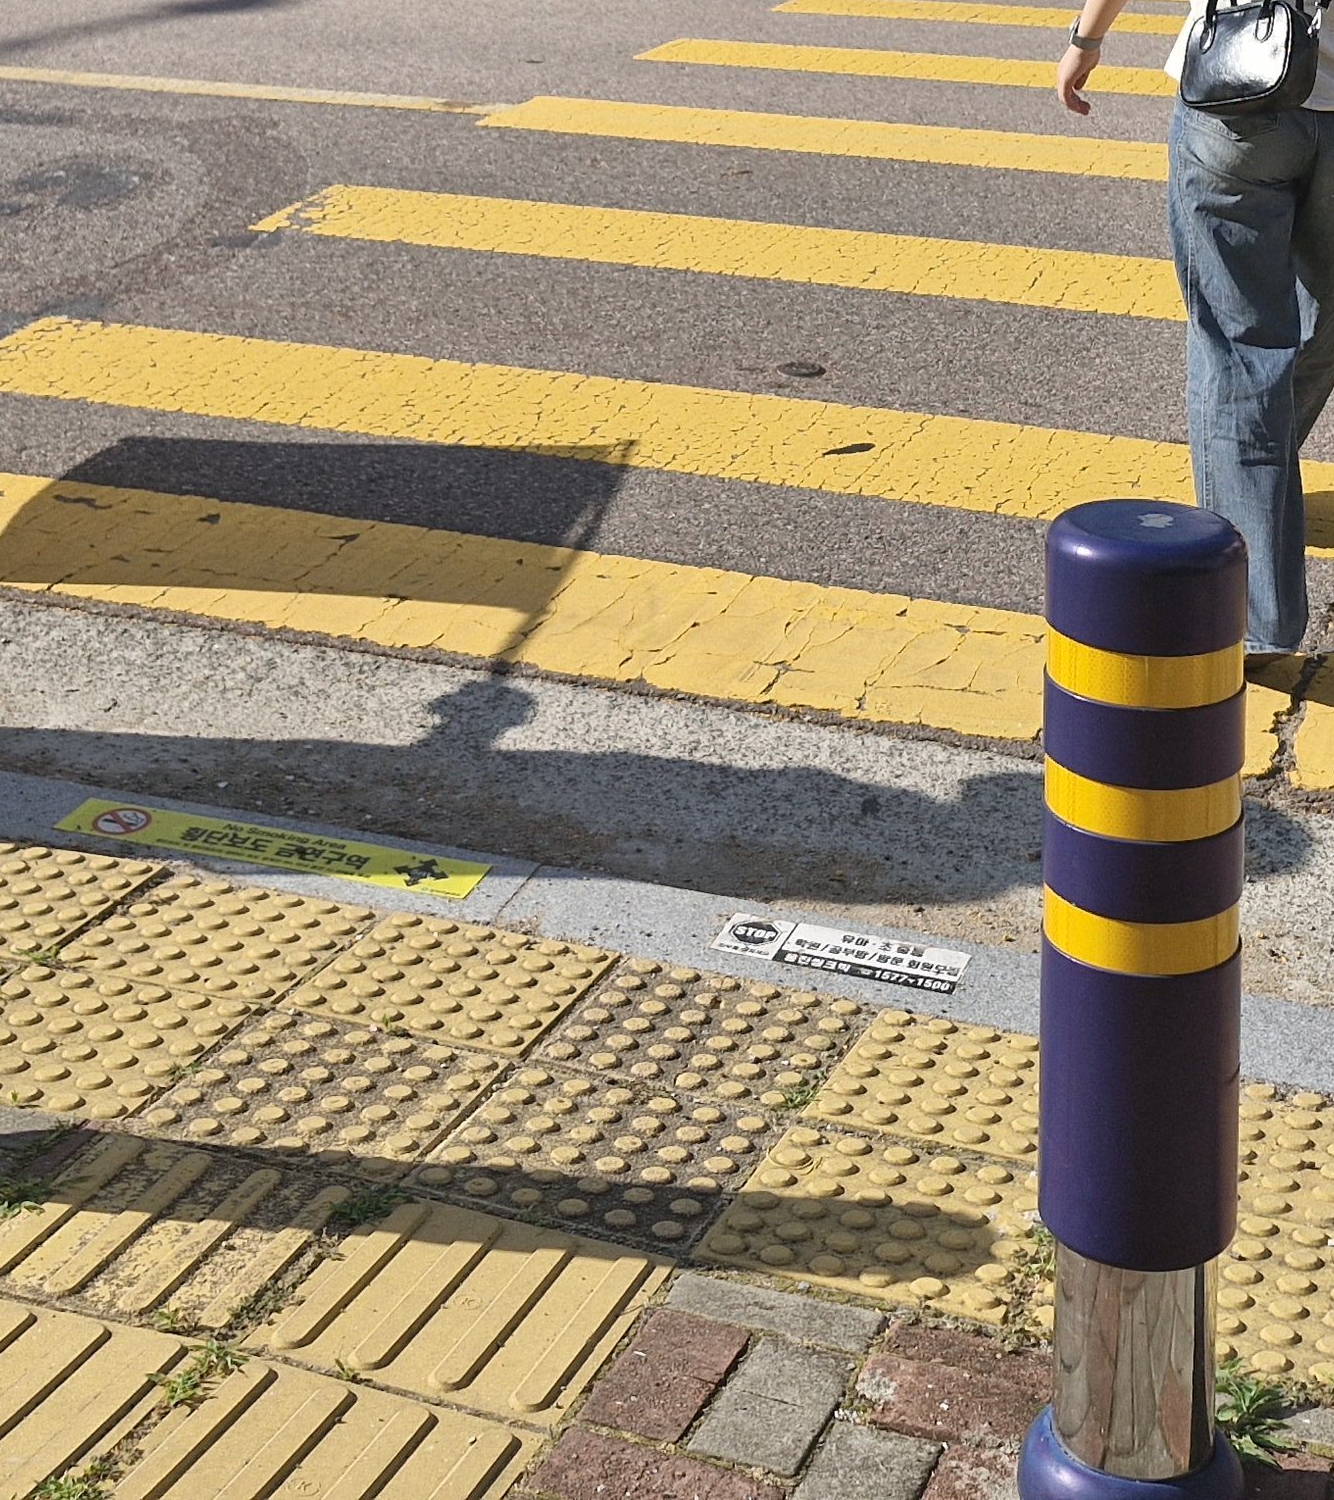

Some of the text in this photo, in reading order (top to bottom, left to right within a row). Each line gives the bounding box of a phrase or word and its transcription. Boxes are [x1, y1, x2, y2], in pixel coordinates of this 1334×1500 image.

[180, 826, 273, 852] 횡단보도
[274, 842, 372, 870] 금연구역
[223, 823, 347, 850] No Smoking Area
[734, 926, 778, 940] STOP
